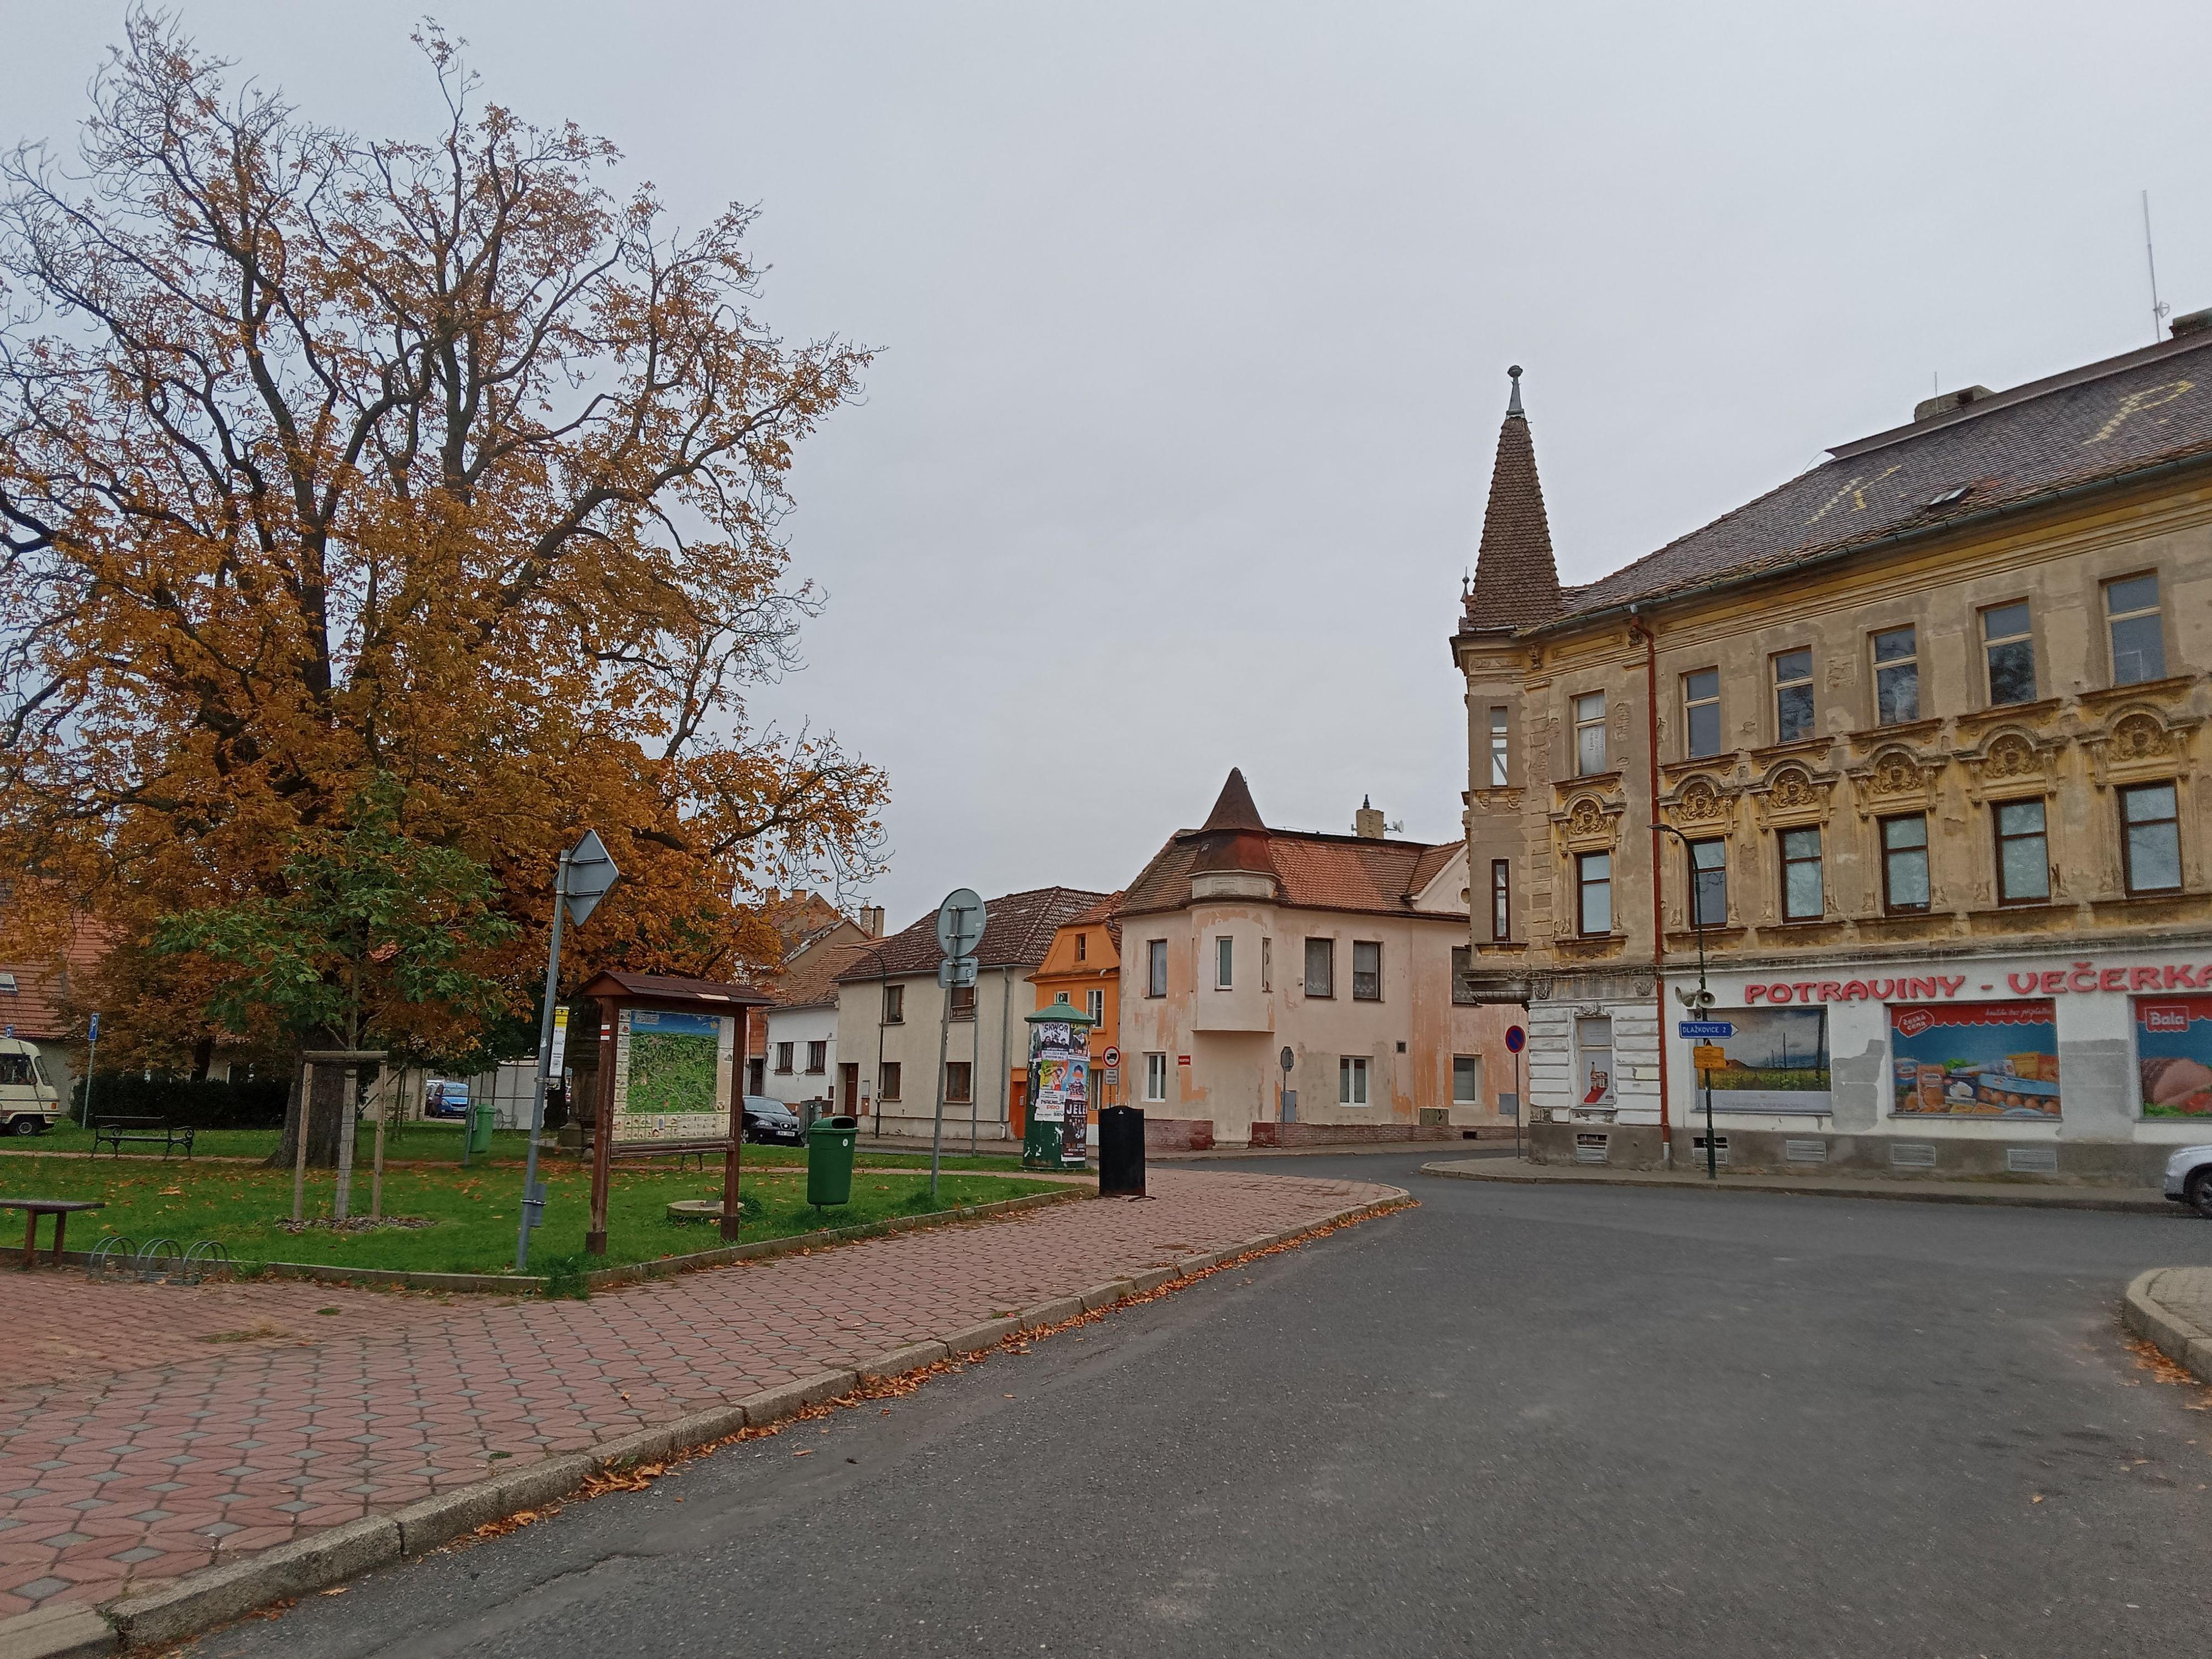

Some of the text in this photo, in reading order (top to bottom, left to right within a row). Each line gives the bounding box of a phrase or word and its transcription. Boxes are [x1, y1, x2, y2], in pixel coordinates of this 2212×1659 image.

[1745, 975, 1965, 1004] POTRAVINY
[2007, 961, 2212, 995] VEČERKA
[91, 1016, 97, 1032] P
[1682, 1025, 1719, 1033] DLAŽKOVICE
